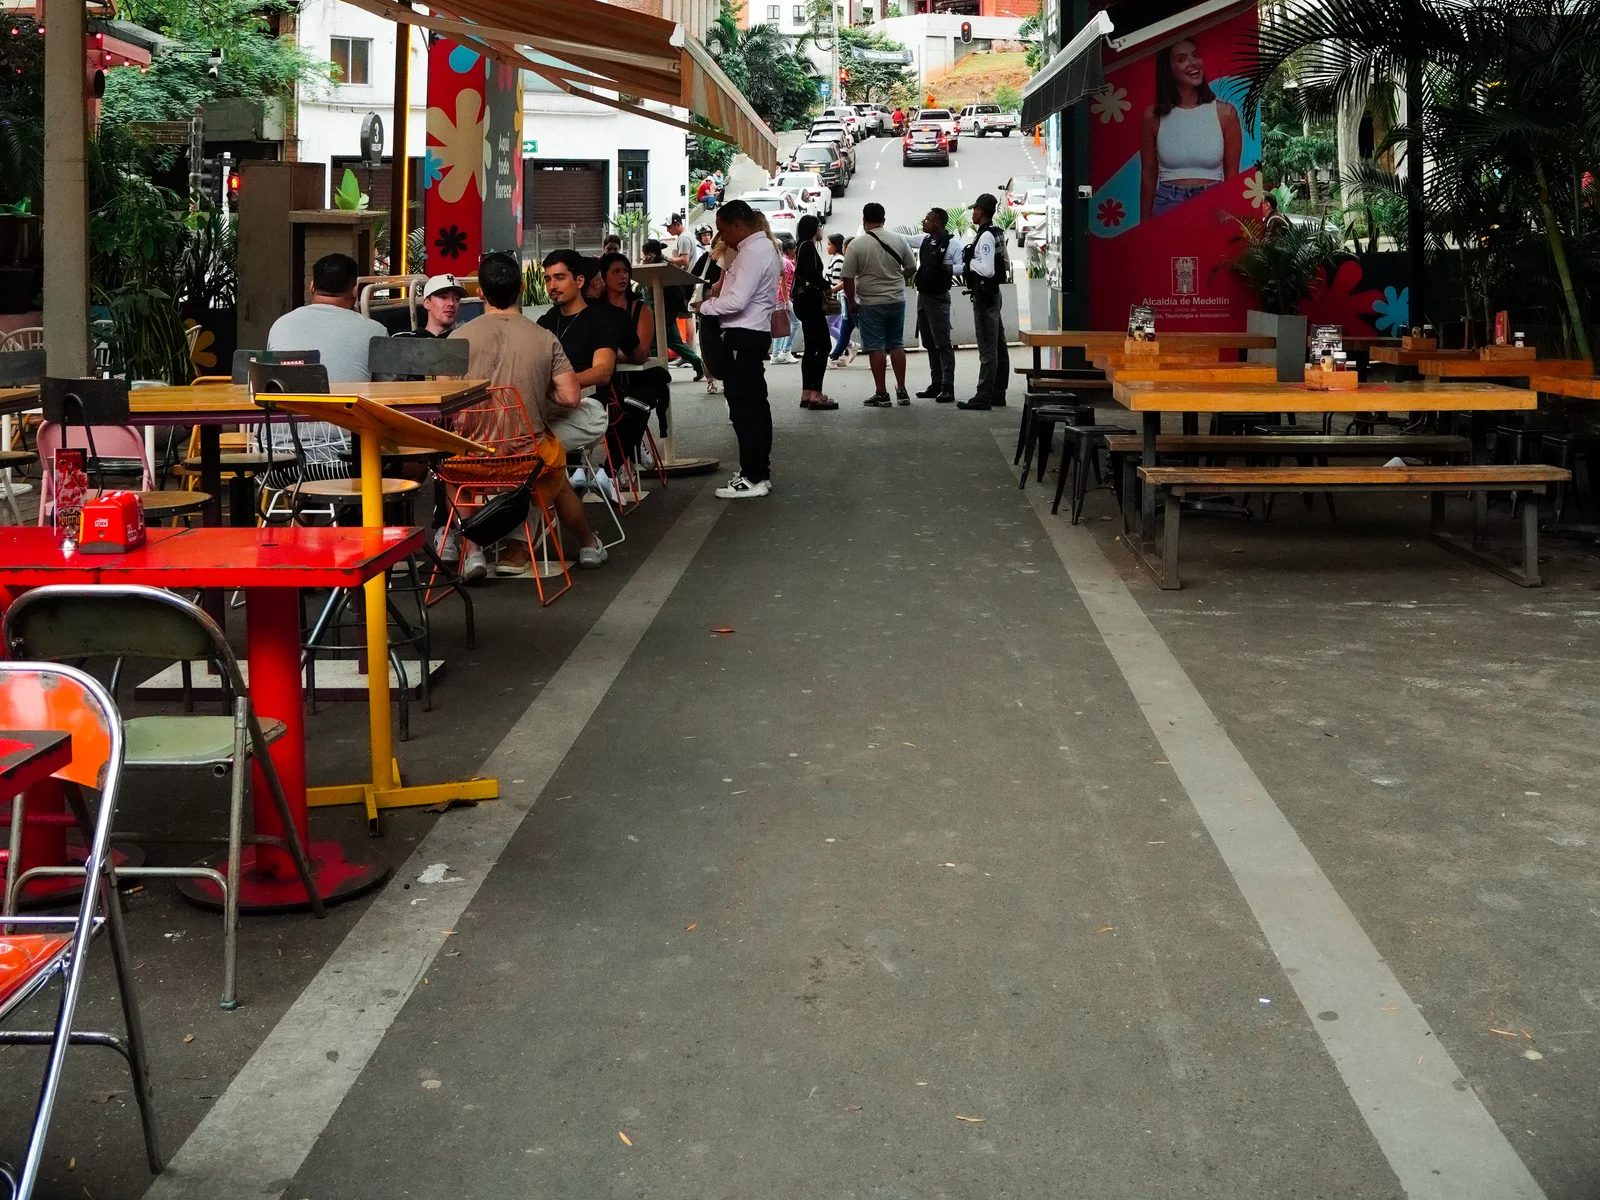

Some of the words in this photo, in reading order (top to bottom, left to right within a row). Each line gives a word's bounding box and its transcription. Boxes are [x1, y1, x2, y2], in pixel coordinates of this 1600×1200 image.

[374, 122, 380, 143] 3
[498, 157, 510, 175] todo
[495, 180, 512, 199] florece
[1179, 297, 1191, 305] de
